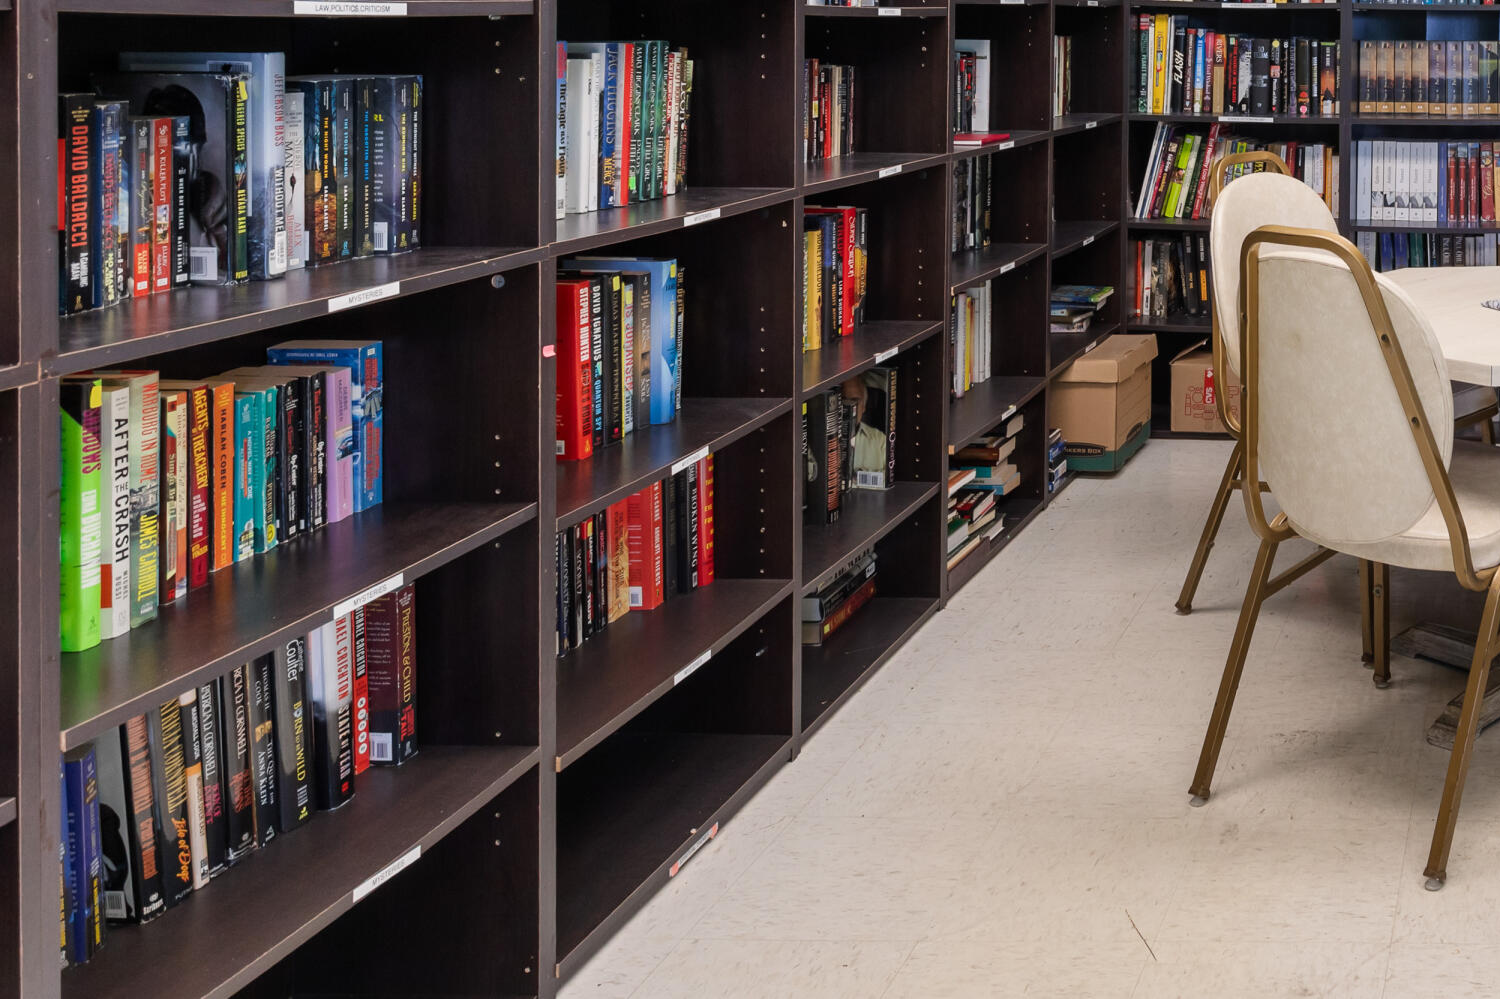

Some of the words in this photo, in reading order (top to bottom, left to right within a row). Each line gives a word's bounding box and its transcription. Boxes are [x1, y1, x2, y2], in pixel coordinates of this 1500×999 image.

[606, 48, 618, 81] JACK
[1172, 50, 1185, 85] FLASH
[1214, 39, 1224, 64] RIVERS
[274, 73, 285, 123] JEFFERSON
[604, 85, 618, 145] HIGGINS
[274, 125, 285, 147] BASS
[633, 105, 641, 136] CLARK
[71, 125, 89, 171] DAVID
[284, 140, 294, 169] MAN
[159, 156, 167, 183] KILLER
[602, 157, 613, 186] MERCY
[237, 189, 247, 215] NEVADA
[274, 168, 285, 216] WITHOUT
[70, 174, 89, 248] BALDACCI
[237, 217, 247, 234] BARR
[348, 288, 384, 304] MYSTERIES
[579, 287, 589, 325] STEPHEN
[592, 285, 602, 314] DAVID
[579, 325, 590, 362] HUNTER
[592, 317, 602, 362] IGNATIUS
[141, 381, 159, 435] WARBURG
[194, 388, 208, 431] AGENTS
[594, 379, 602, 416] QUANTUM
[1205, 387, 1213, 404] CVS
[219, 408, 227, 451] HARLAN
[594, 416, 602, 432] SPY
[114, 417, 129, 481] AFTER
[140, 438, 158, 452] IN
[191, 431, 209, 490] TREACHERY
[139, 453, 158, 484] ROME
[219, 453, 227, 489] COBEN
[115, 481, 129, 494] THE
[115, 494, 130, 563] CRASH
[140, 512, 157, 548] JAMES
[80, 511, 102, 590] BUCHANAN
[137, 549, 157, 603] CARROLL
[401, 607, 412, 653] PRESTON
[285, 638, 301, 682] Coulter
[335, 647, 350, 701] CRICHTON
[354, 640, 366, 677] CRICHTON
[401, 666, 412, 704] CHILD
[234, 707, 247, 760] CORNWELL
[338, 706, 351, 738] STATE
[257, 750, 267, 776] ANNA
[295, 748, 306, 782] WILD
[339, 751, 353, 780] FEAR
[163, 753, 188, 814] CORNWELL
[171, 817, 188, 839] Isle
[174, 850, 192, 883] Dogs
